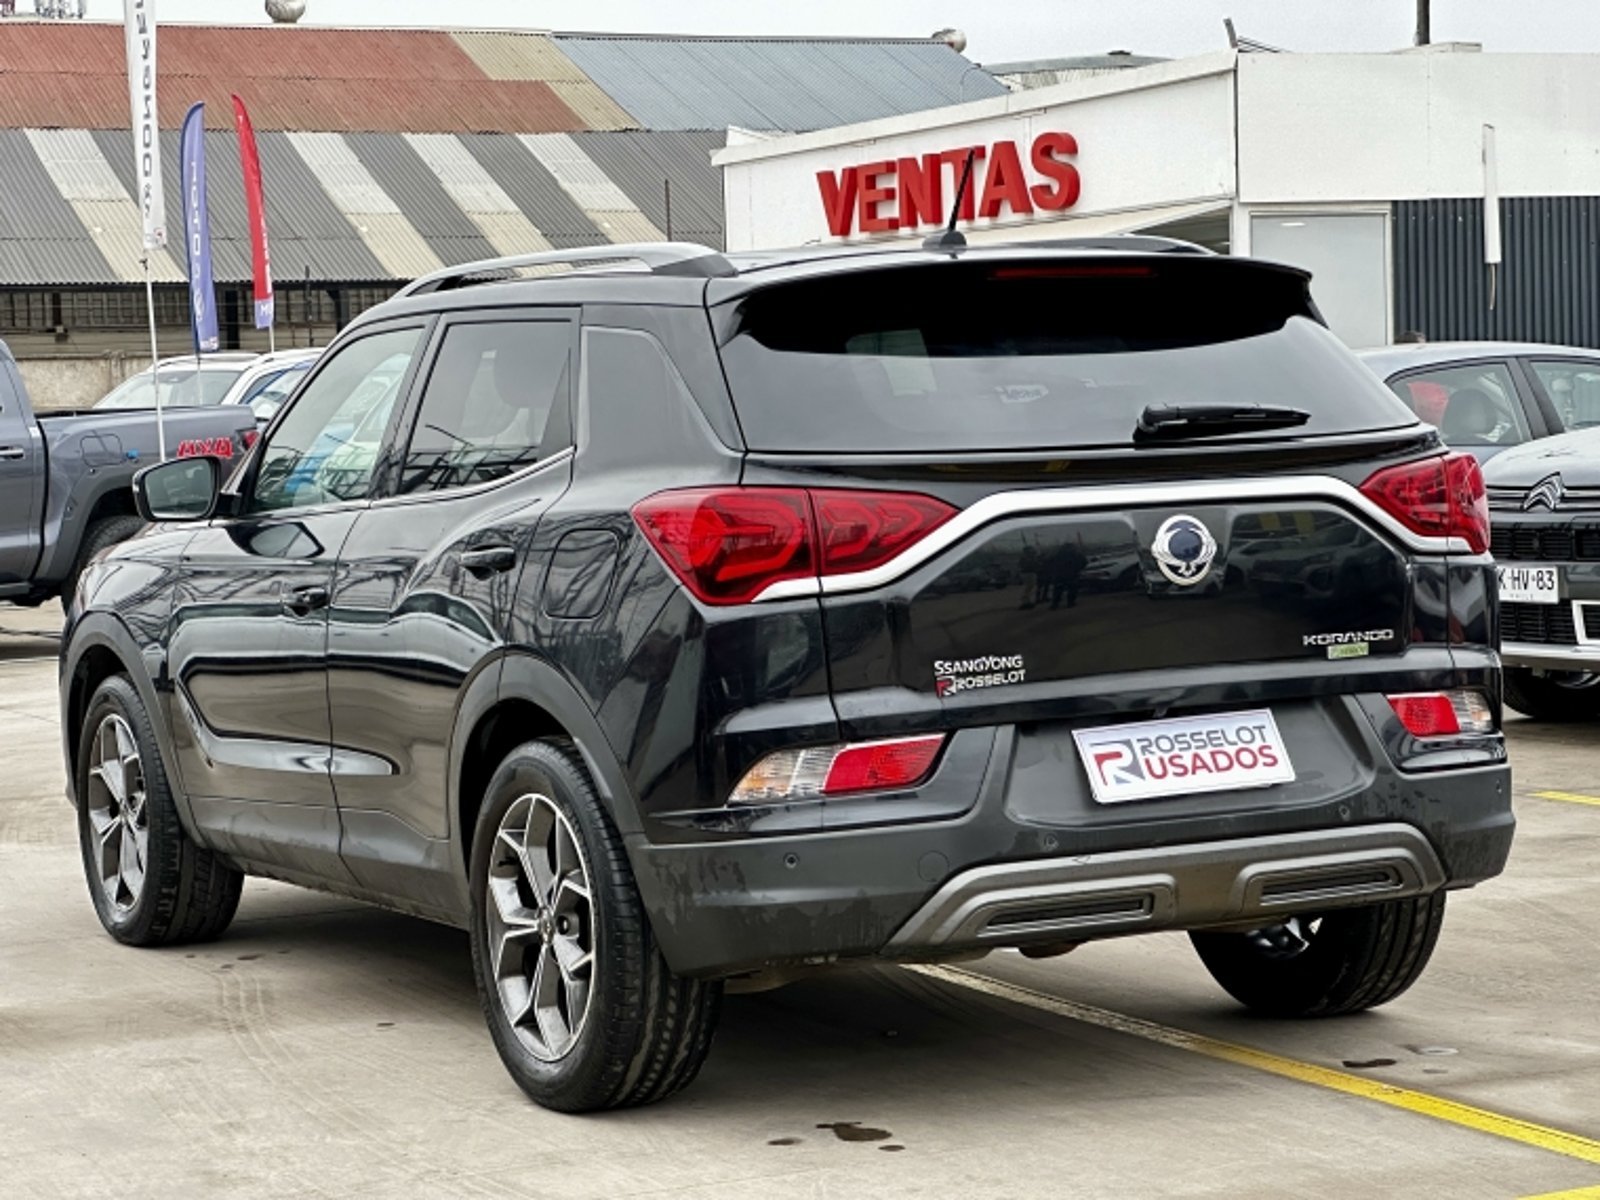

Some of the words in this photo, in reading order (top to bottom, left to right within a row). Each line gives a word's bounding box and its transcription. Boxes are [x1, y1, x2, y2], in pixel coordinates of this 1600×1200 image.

[816, 132, 1081, 237] VENTAS
[1302, 628, 1394, 646] KORANDO
[934, 654, 1023, 674] SSANGYONG
[957, 669, 1026, 690] ROSSELOT
[1137, 725, 1267, 756] ROSSELOT
[1144, 745, 1279, 780] USADOS
